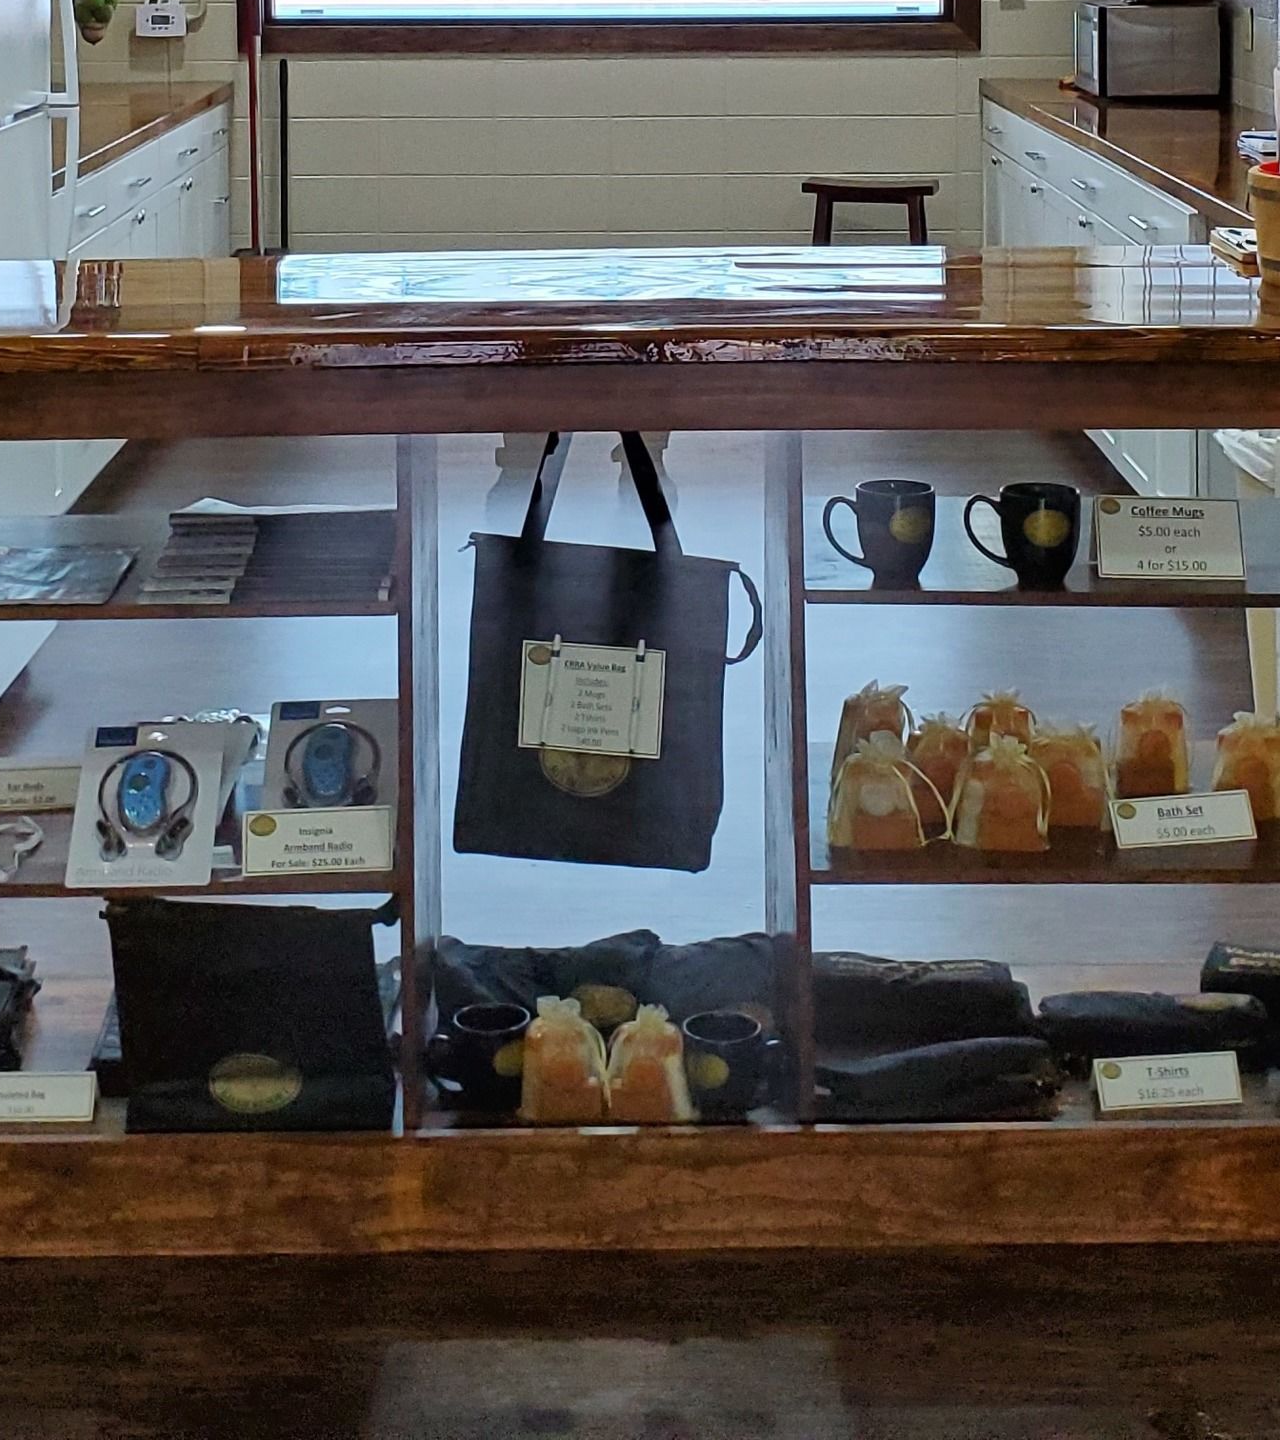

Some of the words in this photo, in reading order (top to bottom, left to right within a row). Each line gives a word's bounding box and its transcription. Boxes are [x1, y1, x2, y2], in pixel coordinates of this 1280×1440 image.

[1130, 505, 1168, 517] Coffee
[1171, 506, 1205, 519] Mugs
[1138, 525, 1171, 538] $5.00
[1173, 526, 1201, 538] each
[1164, 544, 1177, 554] or
[1136, 560, 1144, 570] 4
[1147, 560, 1164, 571] for
[1167, 559, 1208, 571] $15.00
[1157, 806, 1184, 818] Bath
[1186, 805, 1204, 817] Set
[298, 827, 334, 837] Insignia
[1190, 824, 1216, 836] each
[283, 841, 325, 852] Armband
[327, 840, 354, 851] Radio
[271, 860, 286, 869] For
[311, 857, 343, 868] $25.00
[344, 855, 366, 866] Each
[1145, 1066, 1190, 1078] T-Shirts
